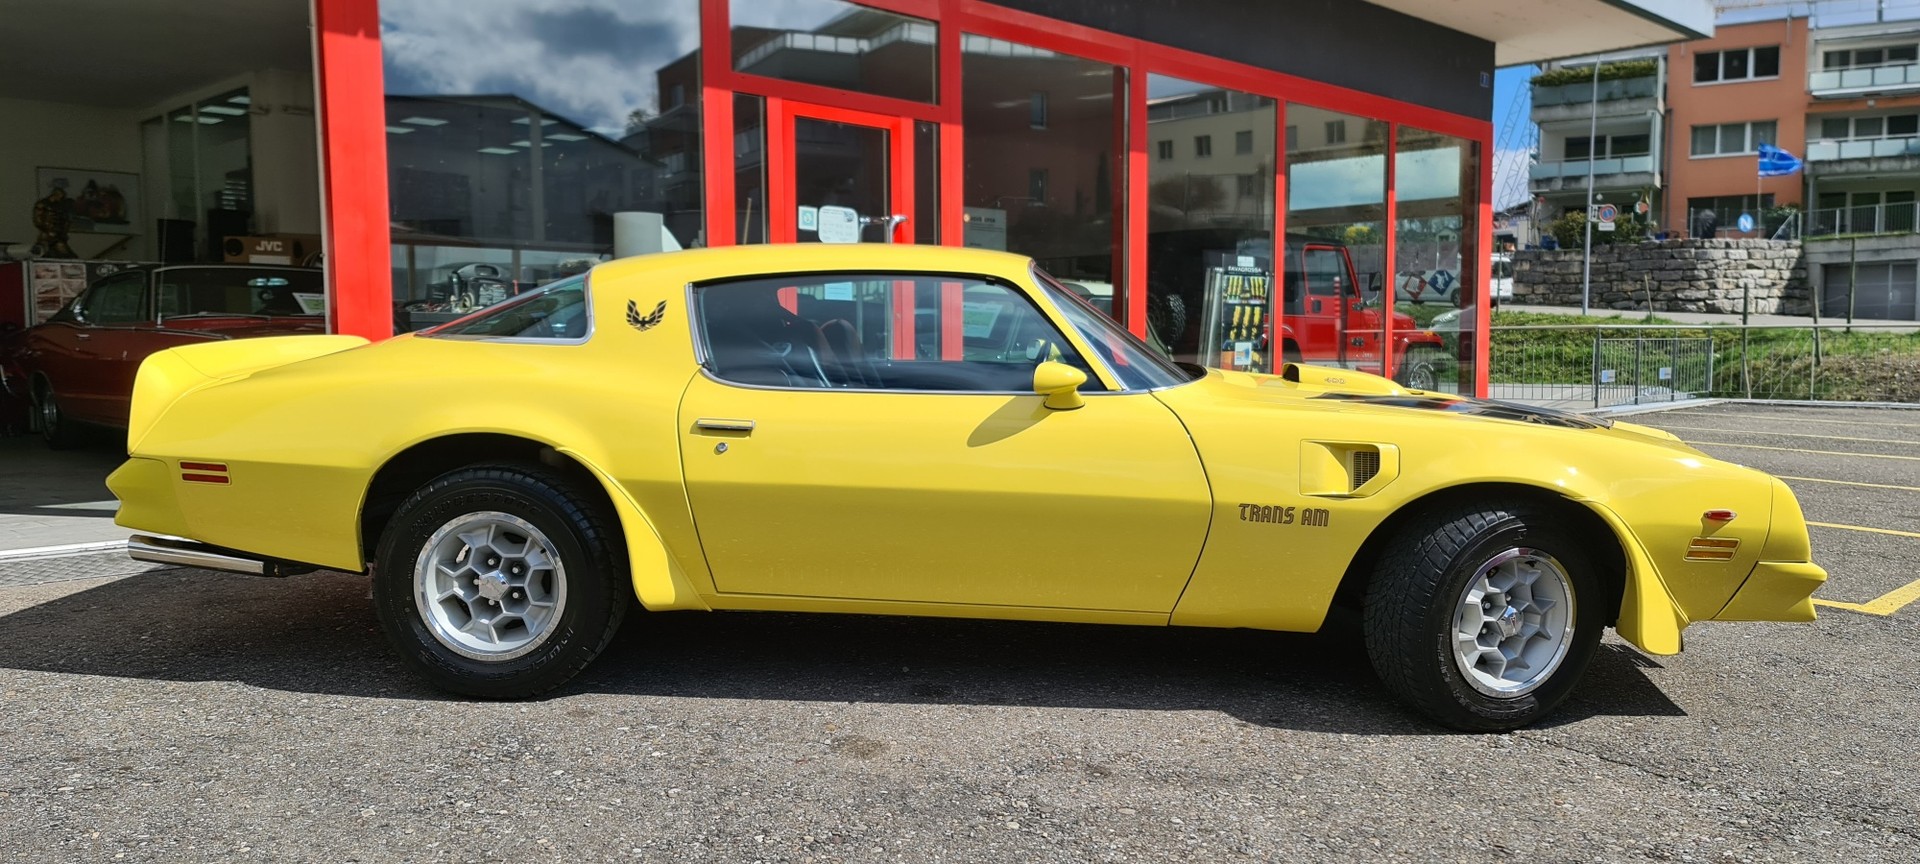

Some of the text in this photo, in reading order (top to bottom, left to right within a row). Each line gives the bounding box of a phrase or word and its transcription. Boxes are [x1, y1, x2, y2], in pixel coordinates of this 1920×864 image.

[1740, 217, 1751, 230] N
[256, 240, 283, 252] JVC
[1238, 503, 1330, 527] TRANS AM
